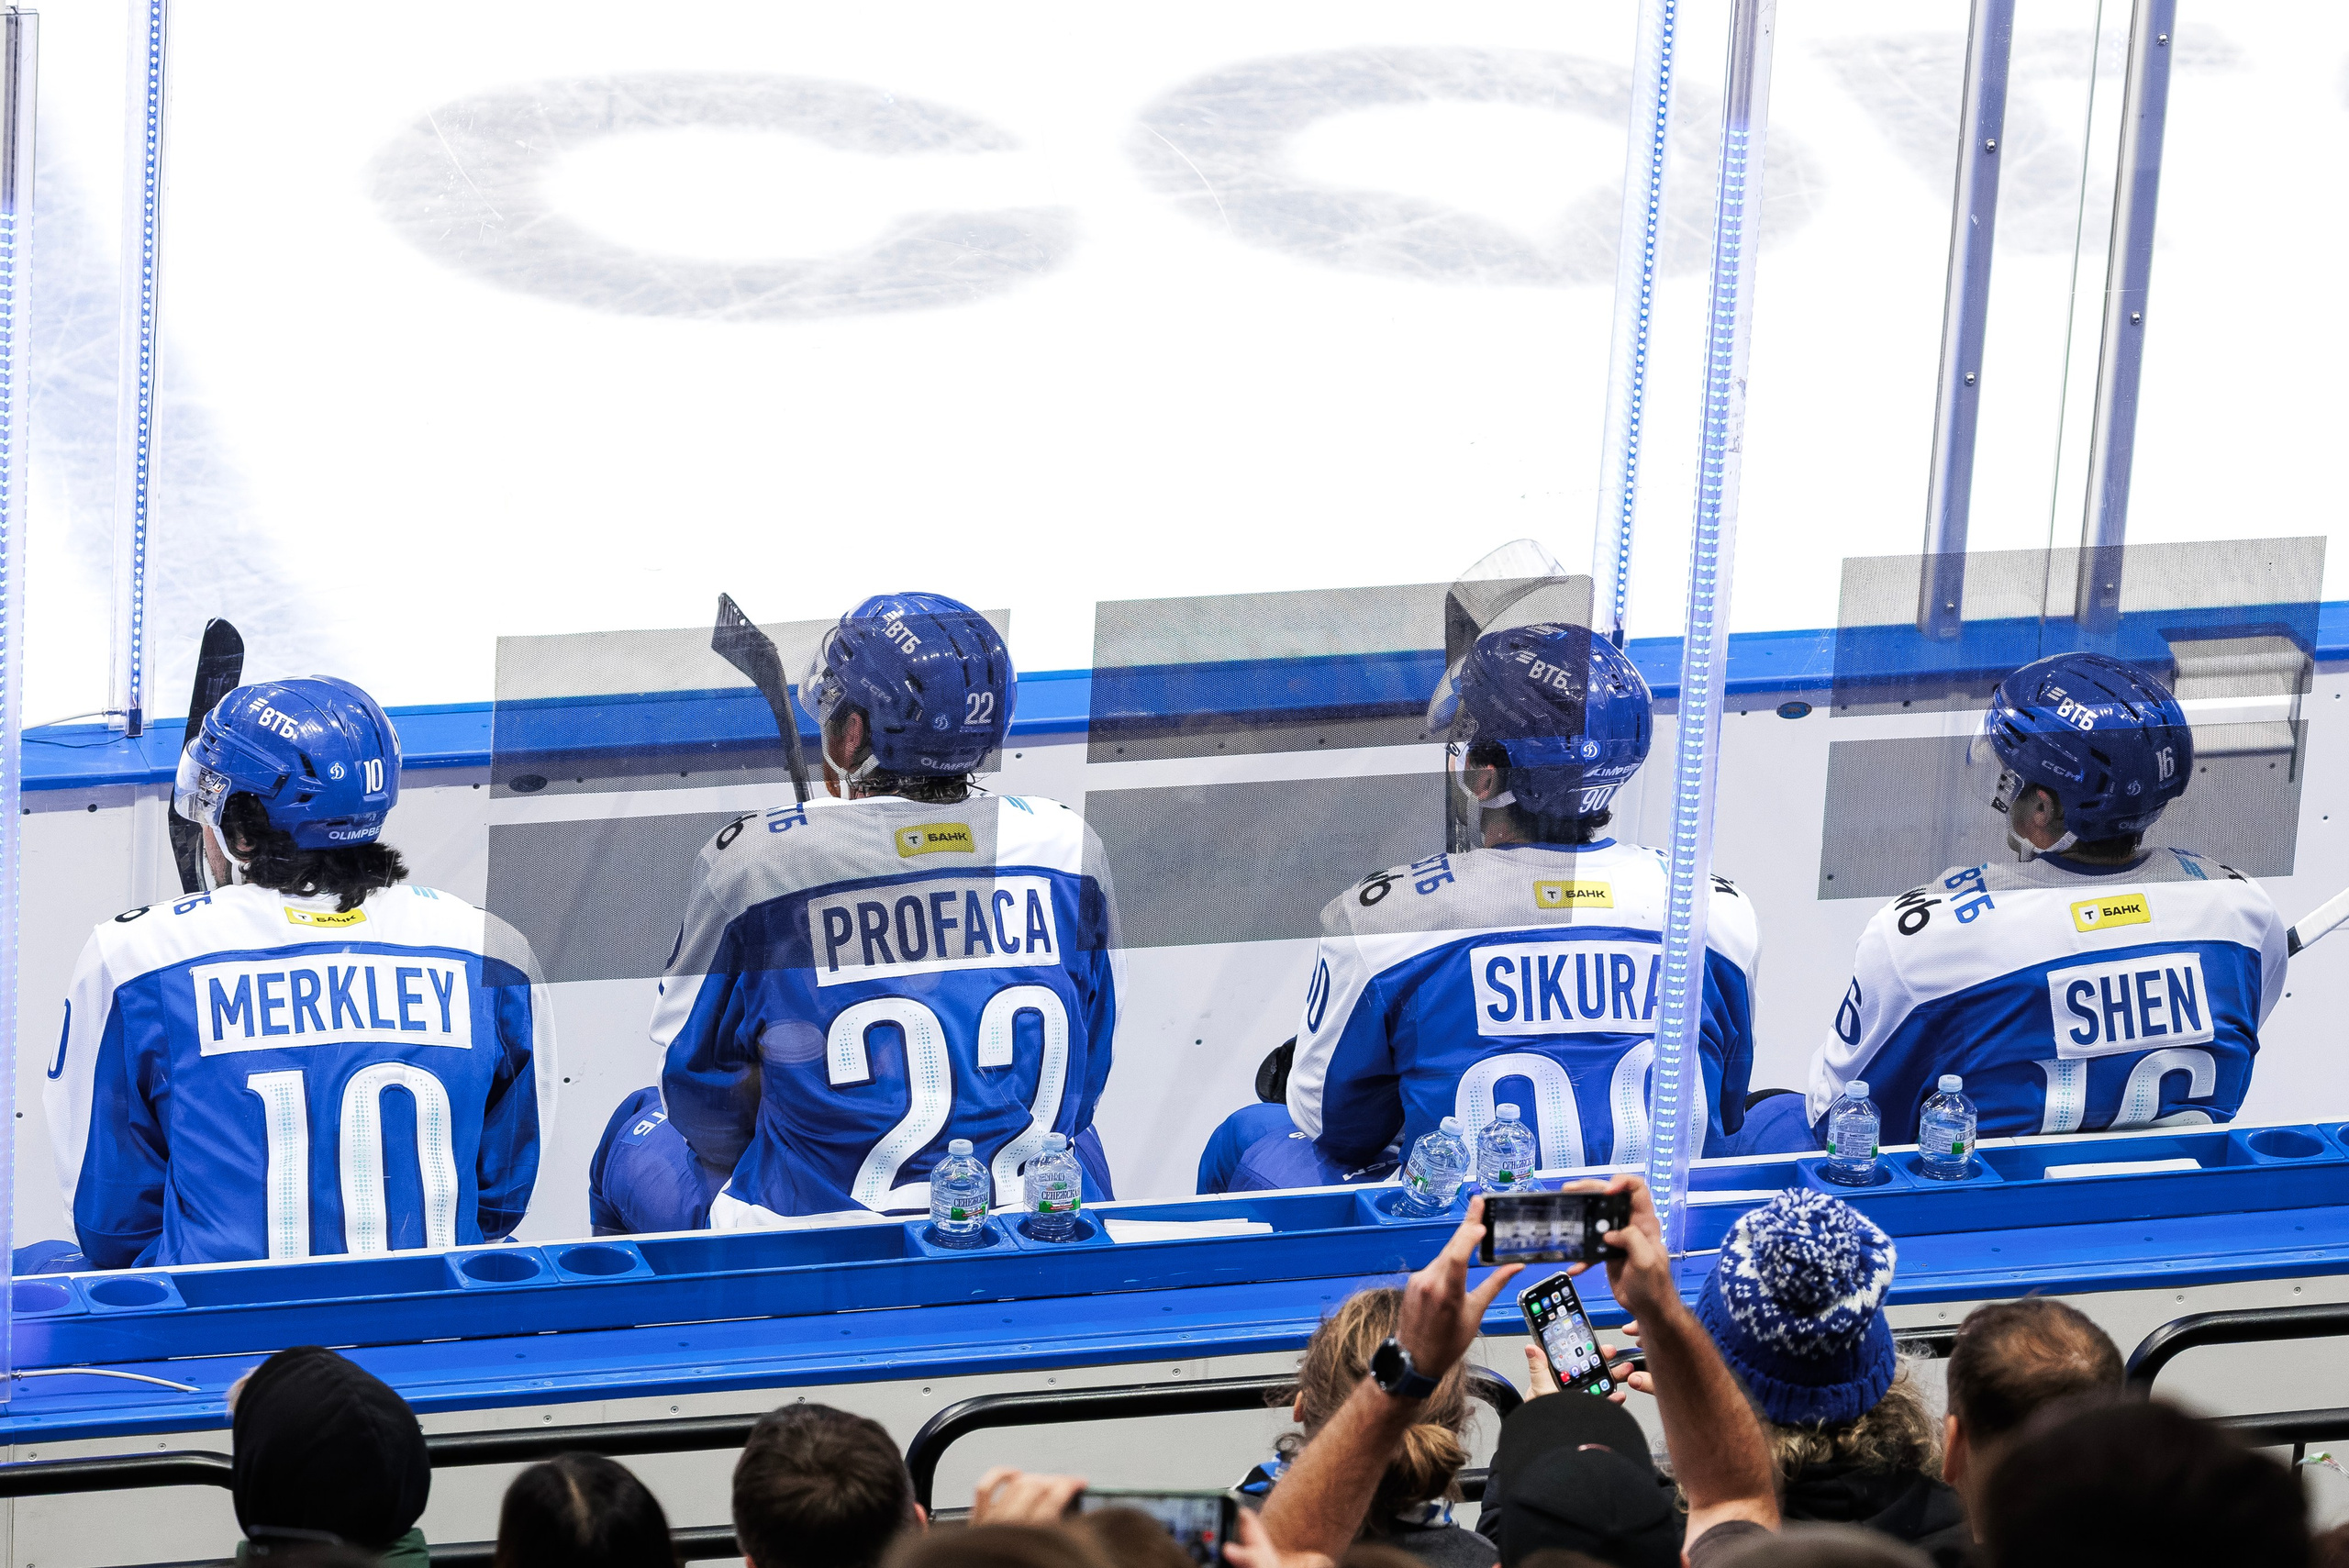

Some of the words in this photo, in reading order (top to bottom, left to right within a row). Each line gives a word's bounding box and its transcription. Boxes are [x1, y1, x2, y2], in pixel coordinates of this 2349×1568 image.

[885, 622, 922, 655] ВТБ
[1528, 660, 1572, 689] ВТБ
[258, 707, 299, 739] ВТБ
[963, 691, 995, 726] 22
[2056, 696, 2099, 731] ВТБ
[363, 758, 384, 795] 10
[2041, 760, 2084, 783] CCM
[2155, 746, 2176, 782] 16
[1579, 786, 1613, 814] 90
[766, 801, 808, 833] ТБ
[928, 831, 968, 842] БАНК
[1565, 890, 1606, 899] БАНК
[1943, 866, 1996, 925] ВТБ
[2103, 904, 2142, 917] БАНК
[316, 915, 357, 924] БАНК
[822, 887, 1054, 973] PROFACA
[208, 964, 455, 1042] MERKLEY
[2066, 966, 2202, 1046] SHEN
[828, 985, 1069, 1211] 22
[632, 1111, 668, 1137] ТБ
[246, 1060, 459, 1260] 10
